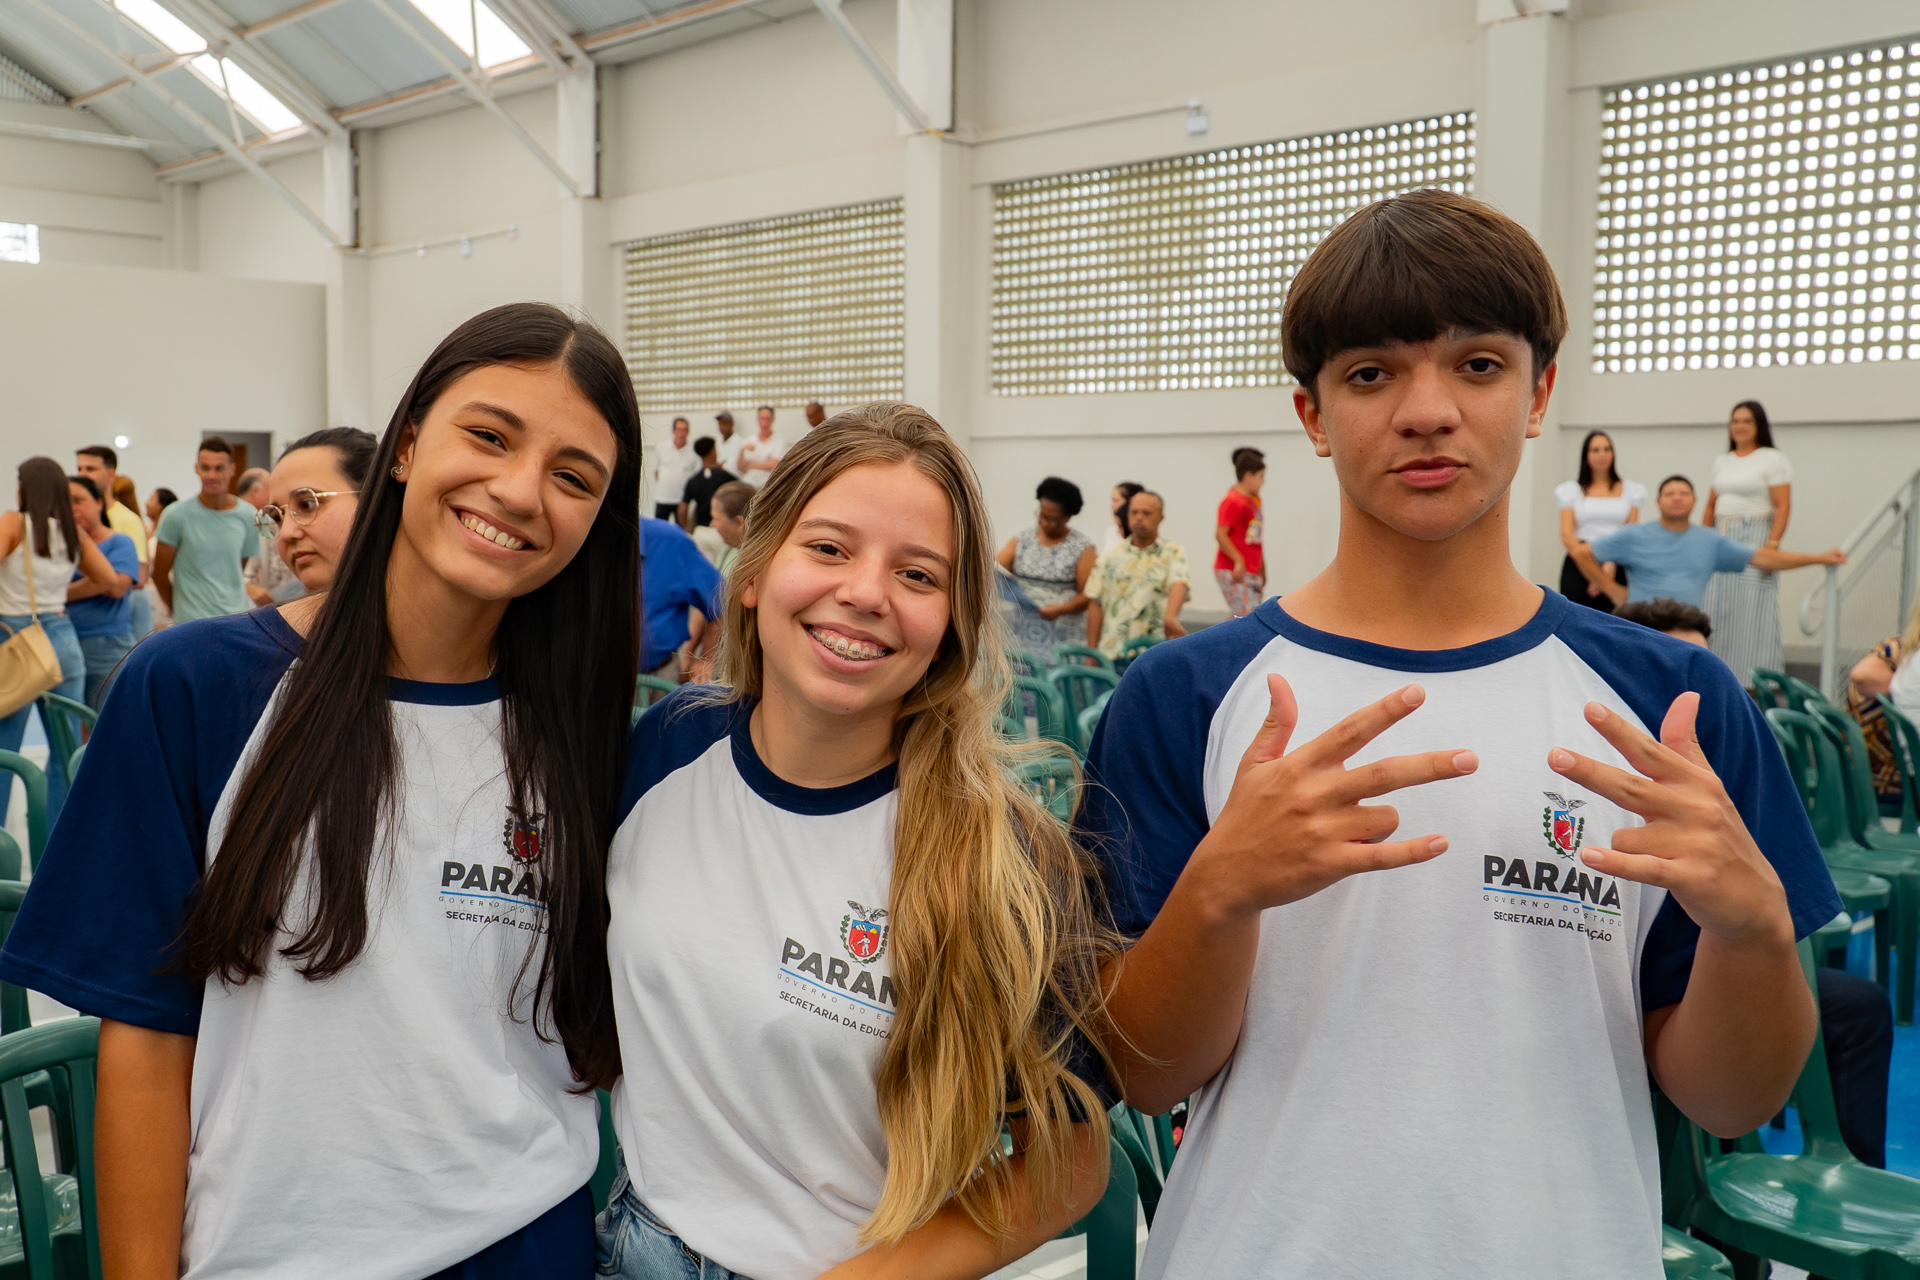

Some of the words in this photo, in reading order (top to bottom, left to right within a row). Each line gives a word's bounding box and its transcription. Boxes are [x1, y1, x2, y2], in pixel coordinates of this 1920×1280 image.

[441, 861, 549, 902] PARA
[438, 896, 500, 908] GOVERNO
[510, 905, 525, 913] DO
[502, 917, 516, 927] DA
[1483, 894, 1550, 909] GOVERNO
[1562, 904, 1580, 914] DO
[1583, 912, 1622, 927] STADO
[1493, 911, 1555, 928] SECRETARIA
[1558, 919, 1574, 931] DA
[781, 936, 898, 1008] PARAN
[777, 973, 838, 1003] GOVERNO
[849, 1003, 866, 1014] DO
[779, 990, 839, 1023] SECRETARIA
[842, 1017, 857, 1030] DA
[859, 1023, 892, 1040] EDUCA
